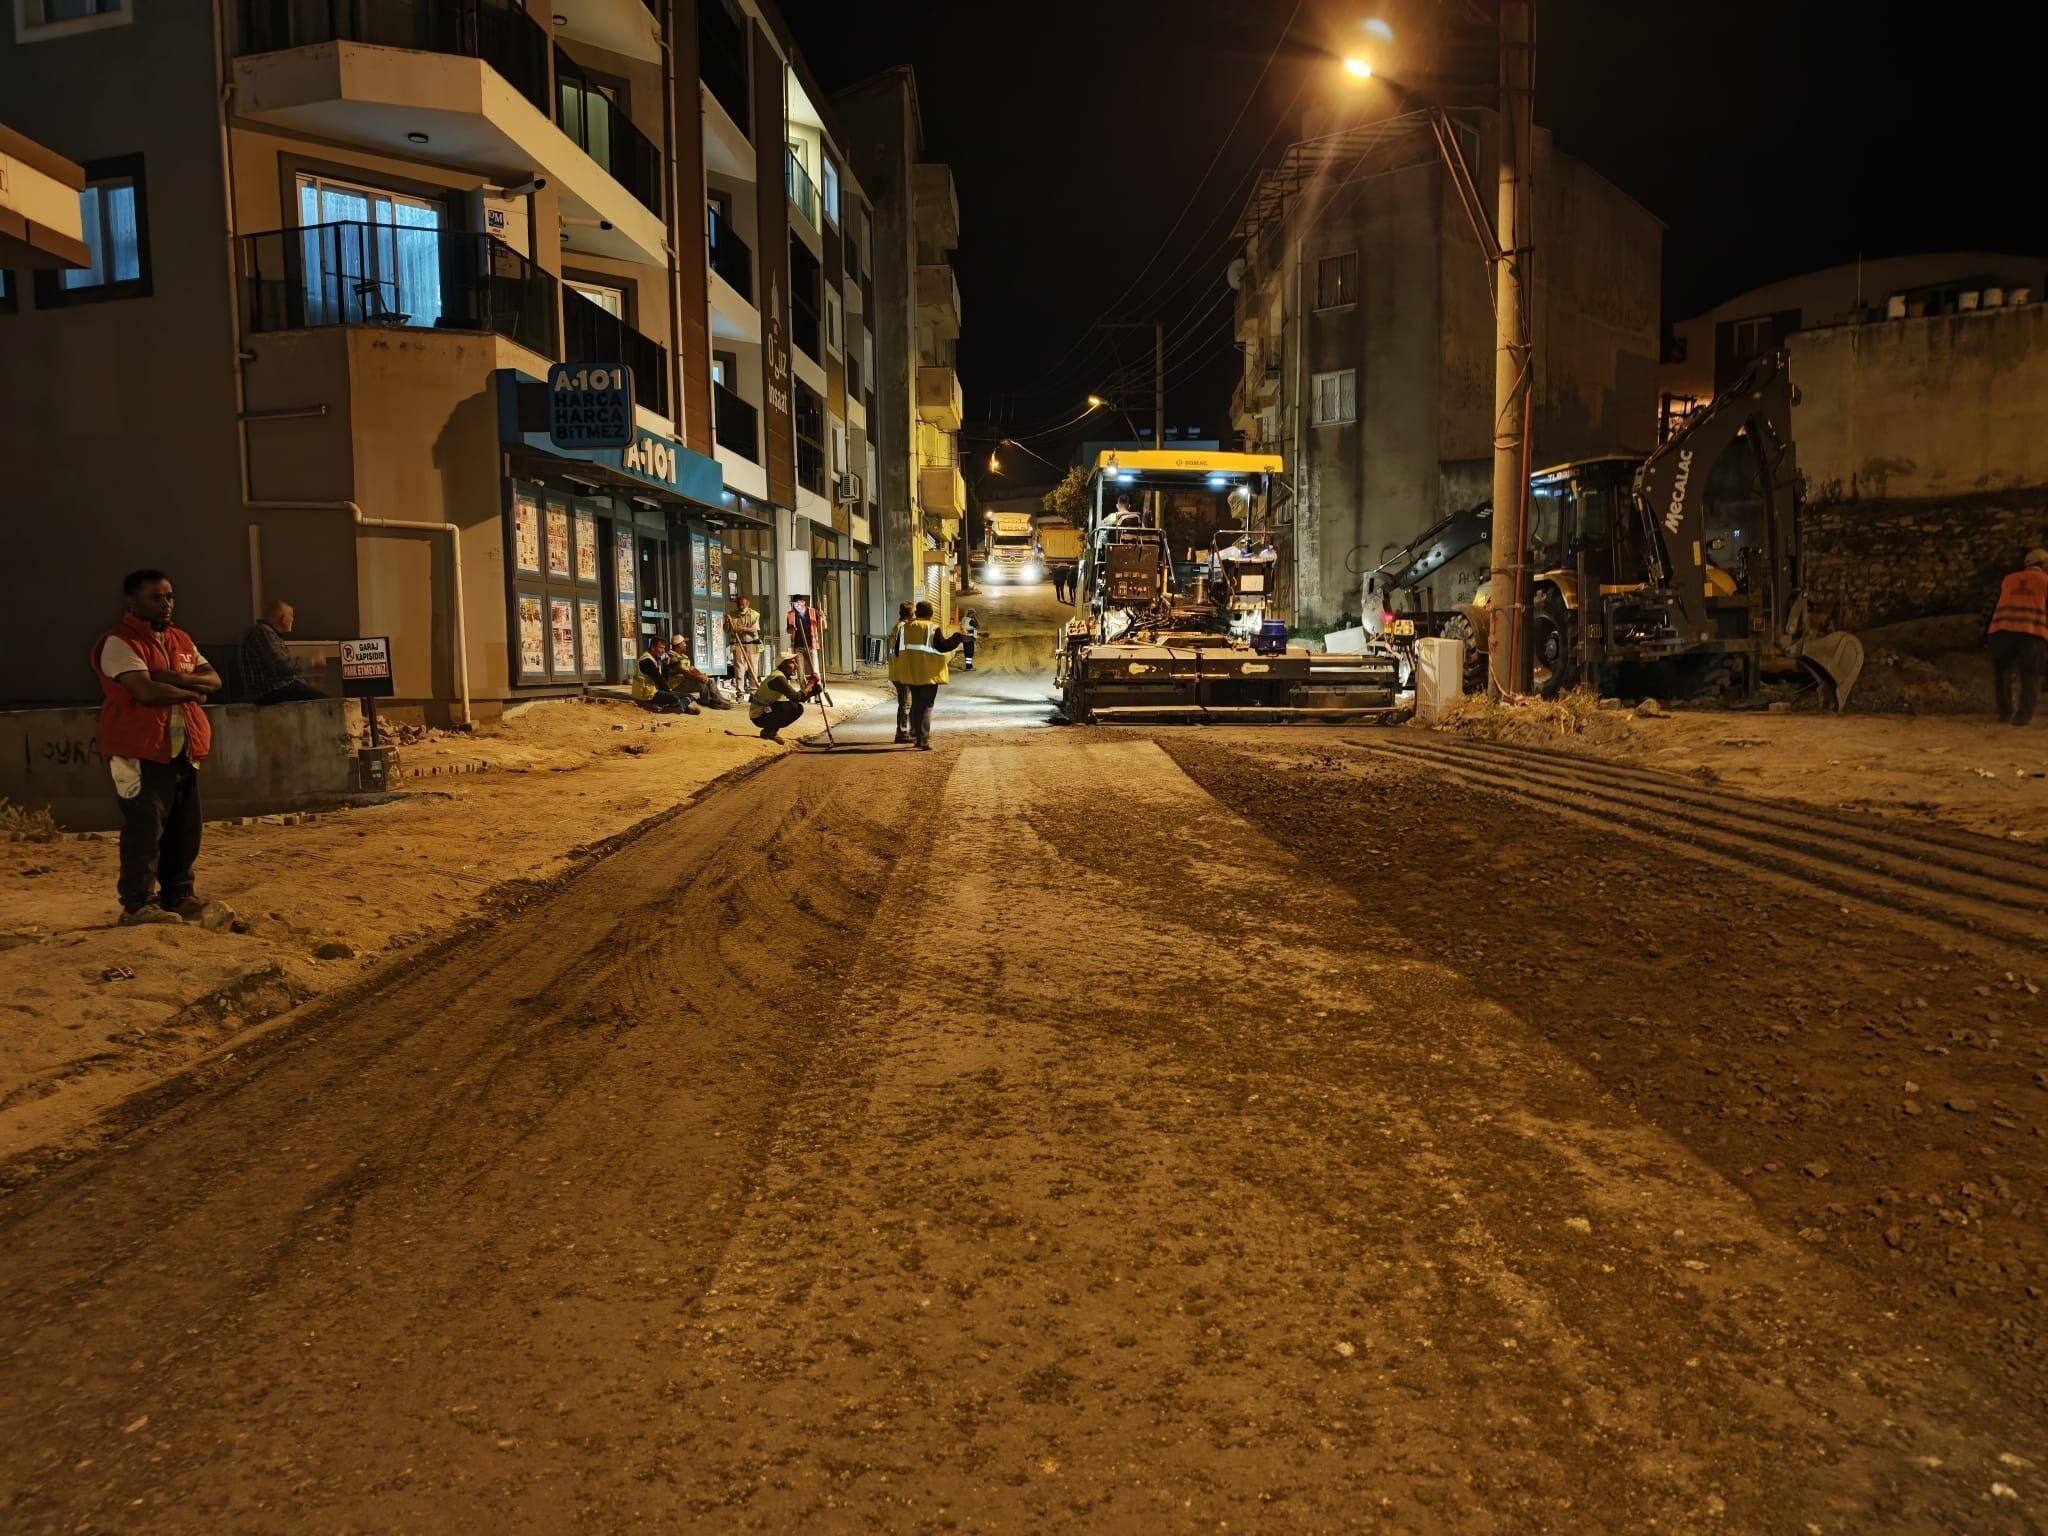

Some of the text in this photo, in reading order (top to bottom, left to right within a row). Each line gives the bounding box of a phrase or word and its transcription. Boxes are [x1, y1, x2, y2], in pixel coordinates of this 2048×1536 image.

[554, 391, 622, 408] HARCA
[555, 408, 624, 424] HARCA
[359, 643, 379, 651] GARAJ
[356, 652, 385, 661] KAPISIDIR
